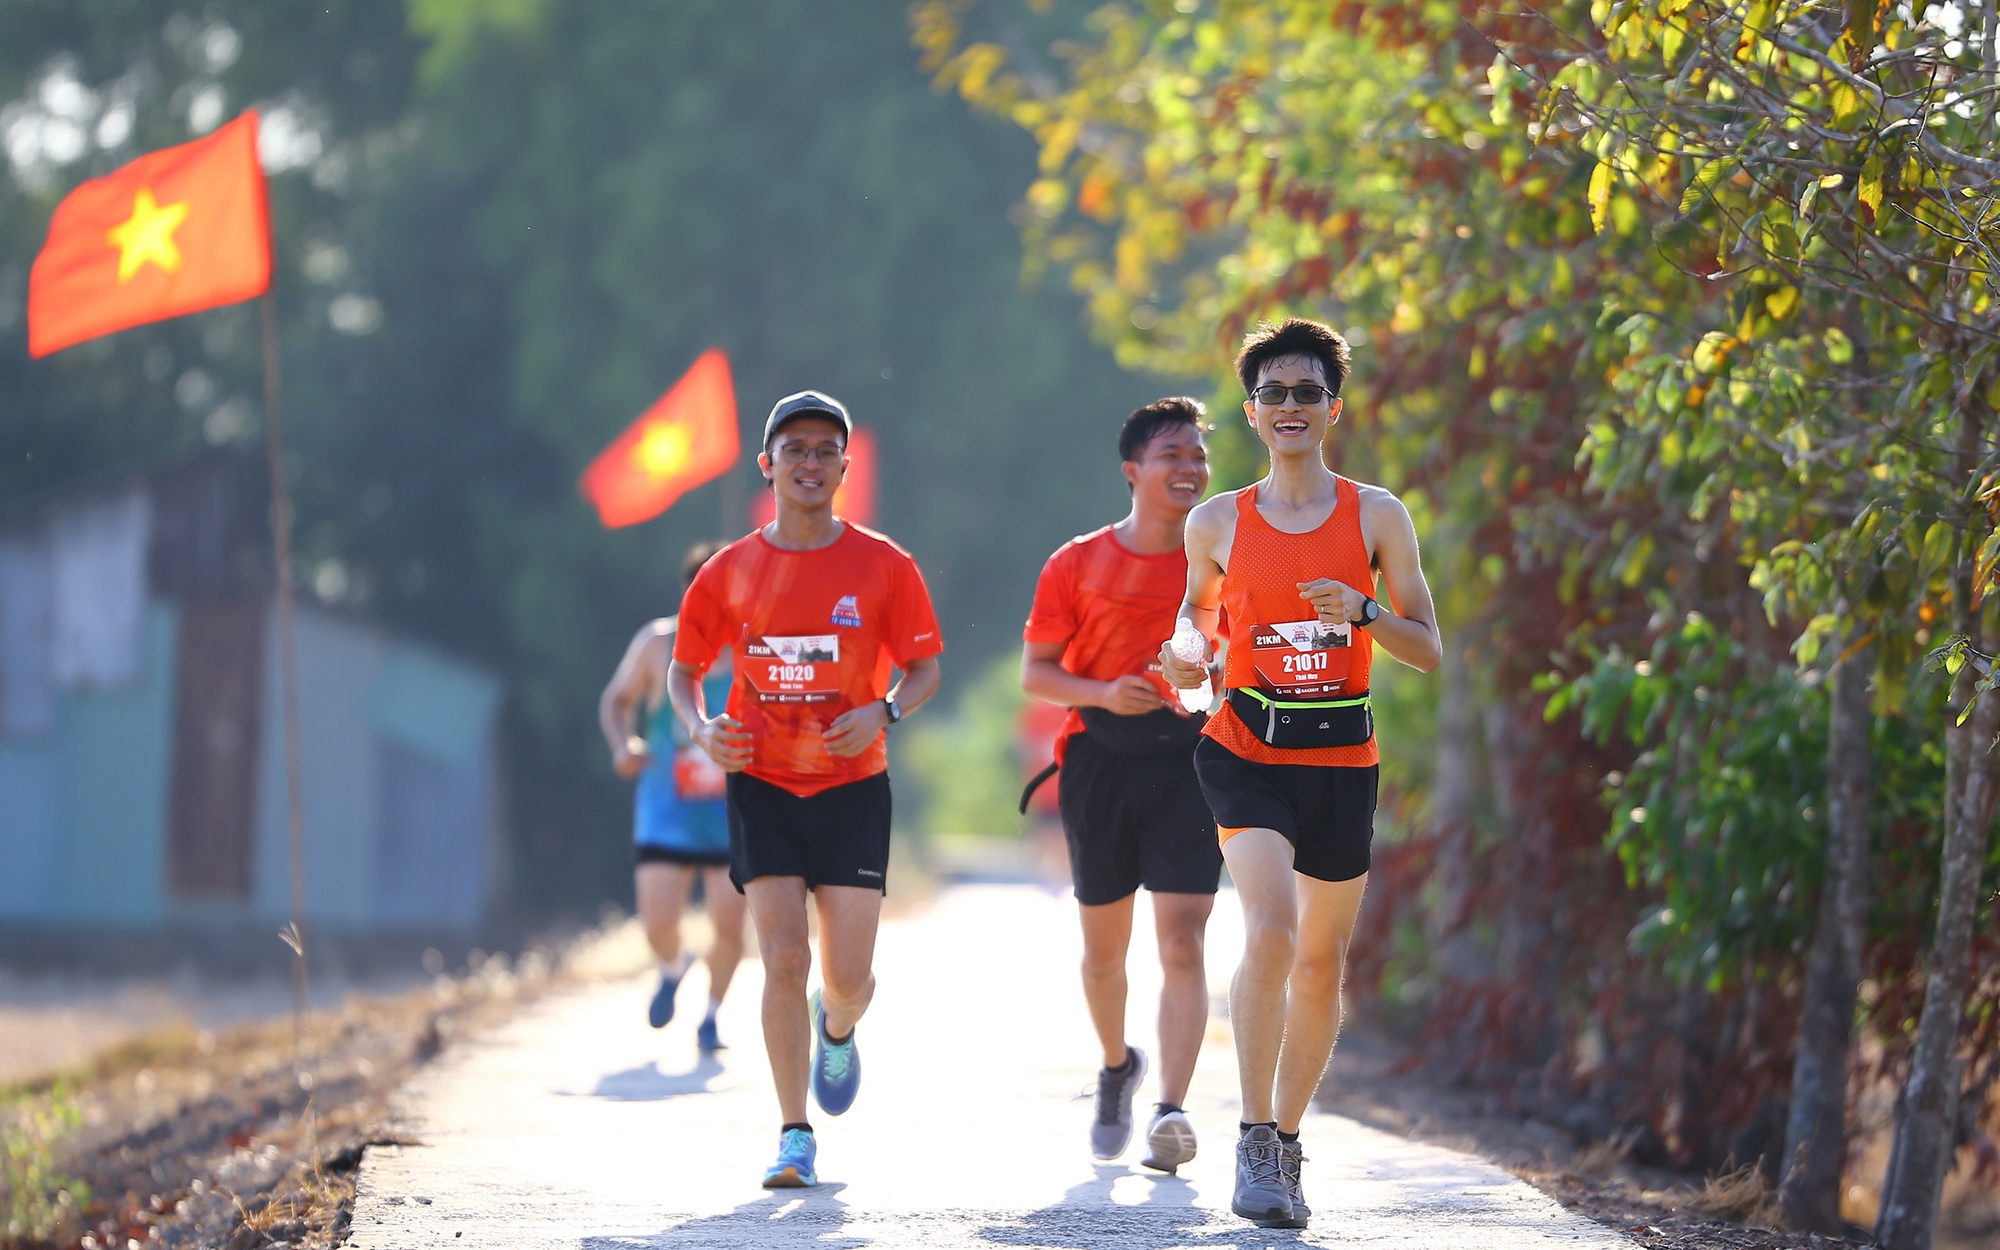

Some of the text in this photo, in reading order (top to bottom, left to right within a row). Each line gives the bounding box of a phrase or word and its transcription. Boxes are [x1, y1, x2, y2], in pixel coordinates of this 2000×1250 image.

[1255, 634, 1282, 645] 21KM
[748, 645, 771, 655] 21KM
[1282, 652, 1328, 673] 21017
[768, 665, 815, 681] 21020
